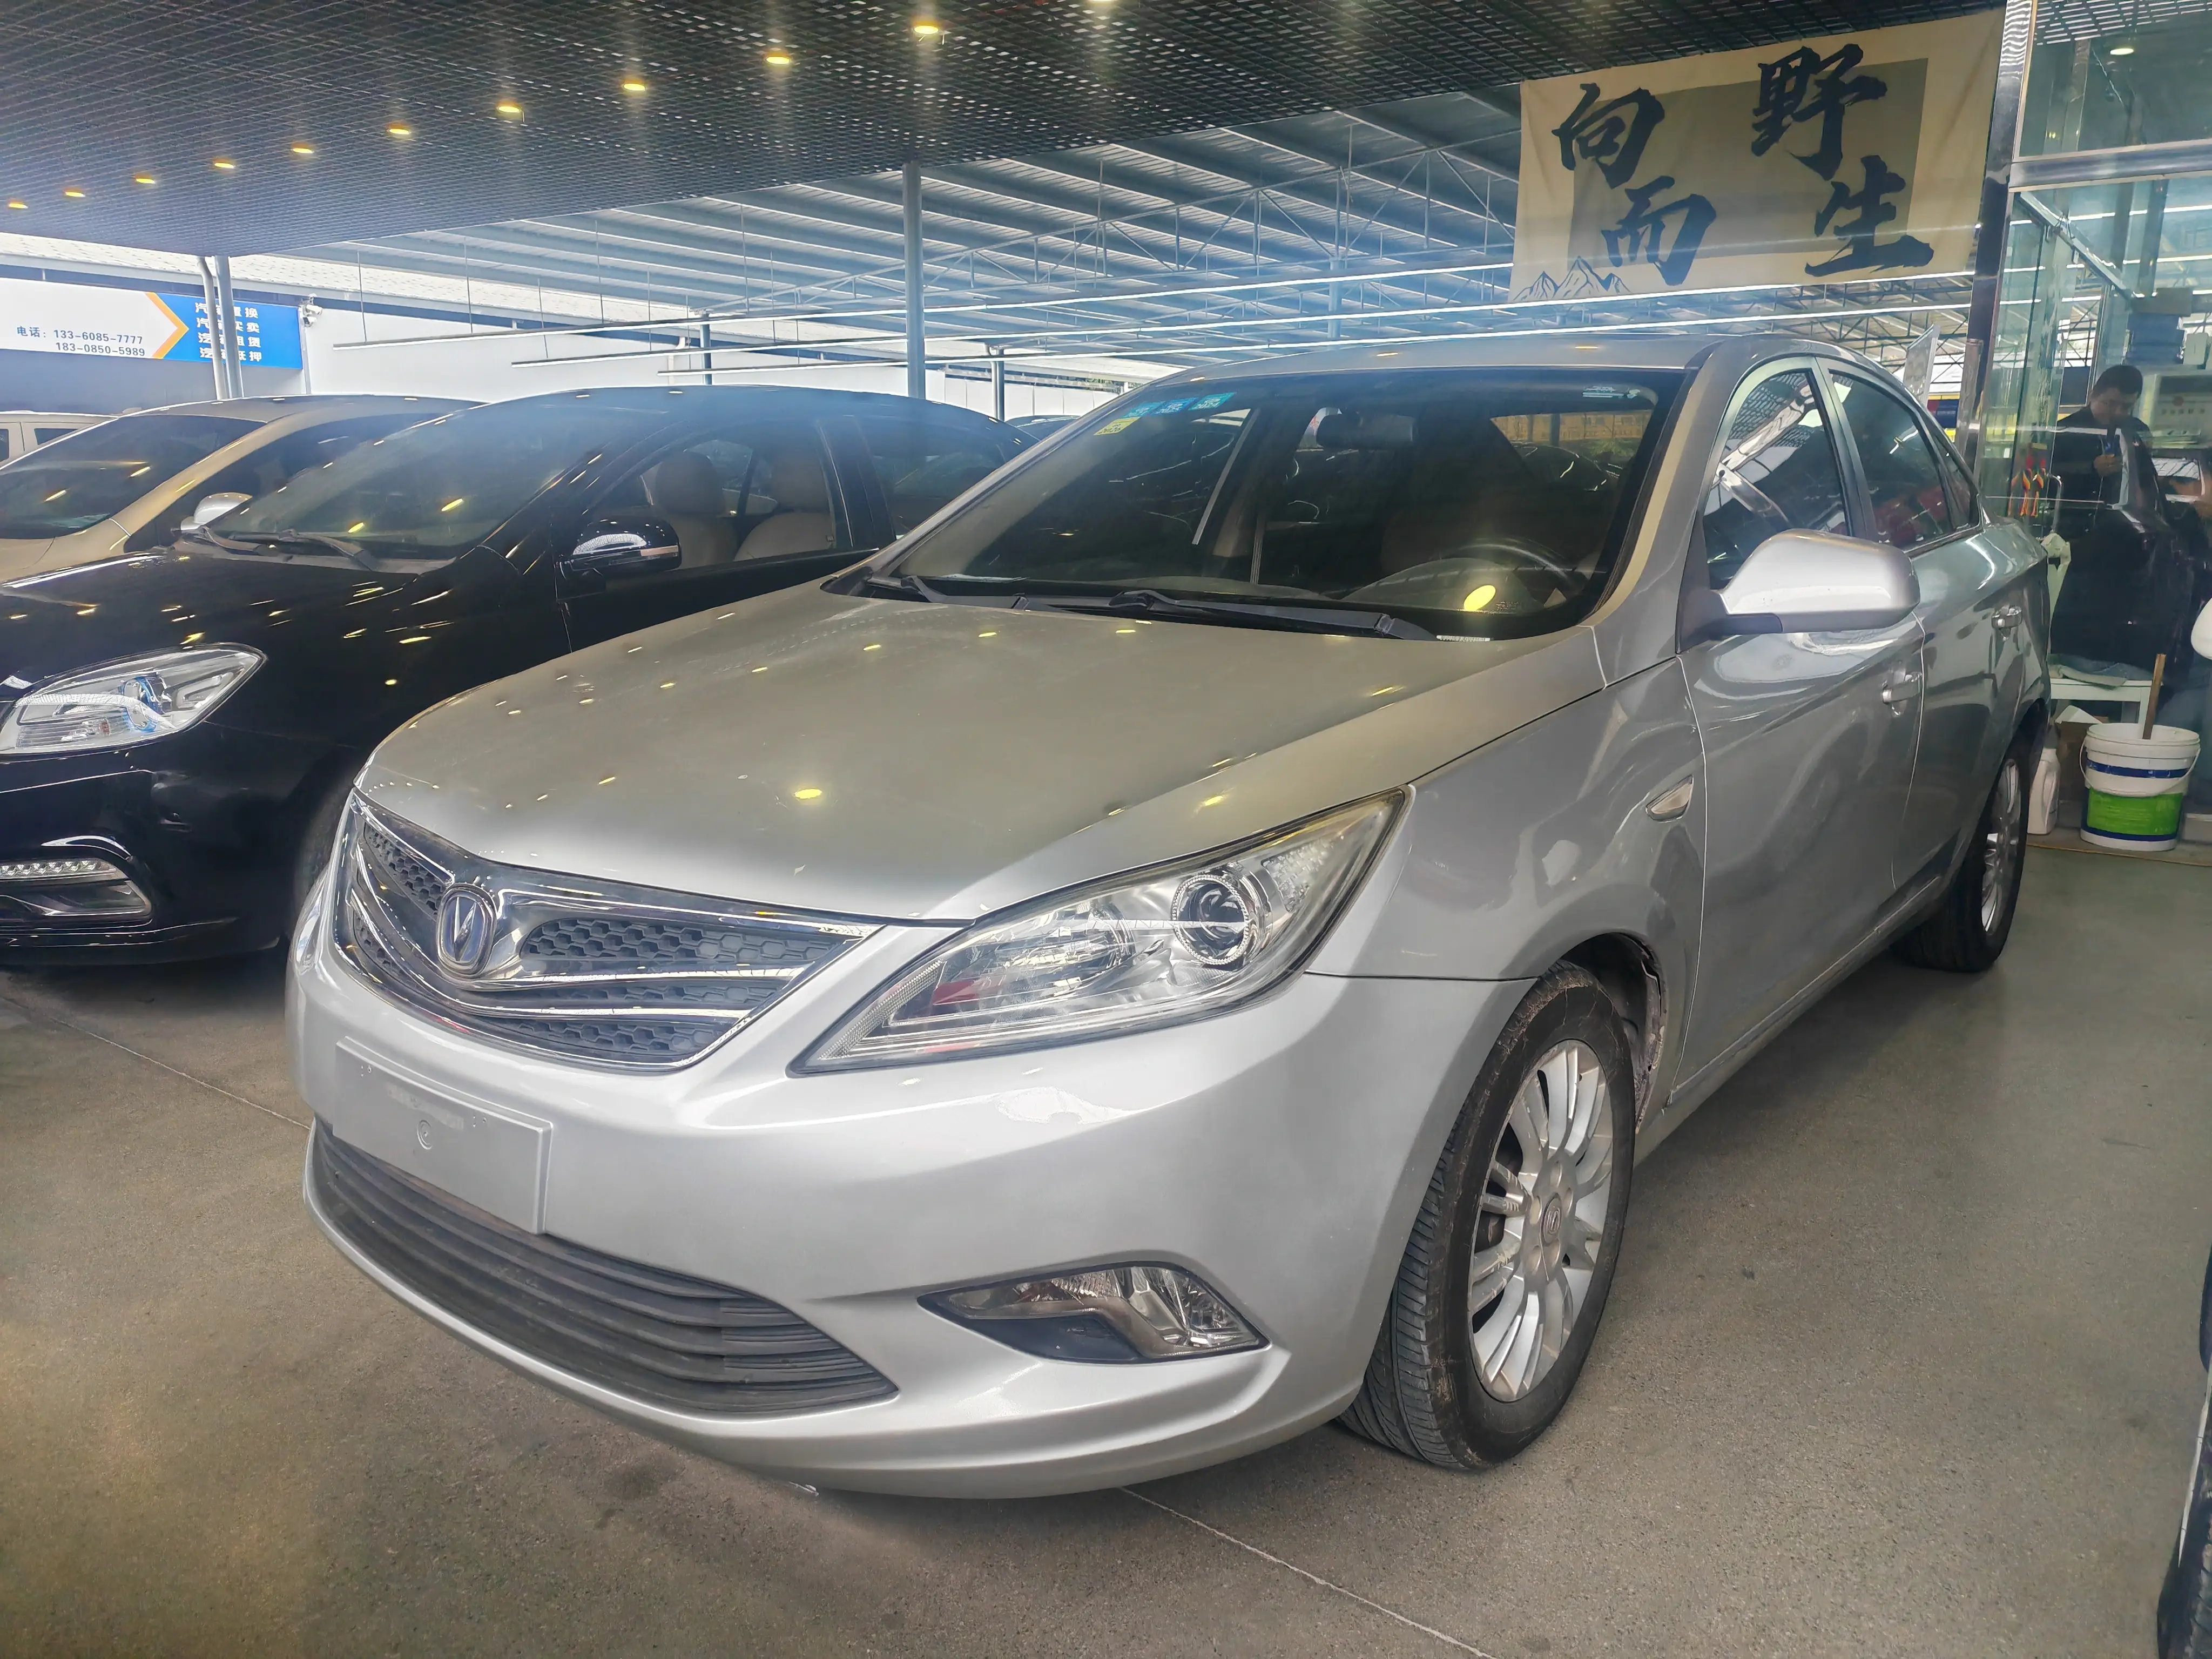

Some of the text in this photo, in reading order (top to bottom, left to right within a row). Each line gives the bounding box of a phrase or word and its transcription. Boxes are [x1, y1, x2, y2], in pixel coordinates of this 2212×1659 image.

[1552, 43, 1887, 188] 向 野
[1601, 155, 1934, 286] 而 生
[53, 329, 143, 345] 133-6085-7777
[56, 342, 145, 356] 183-0850-5989
